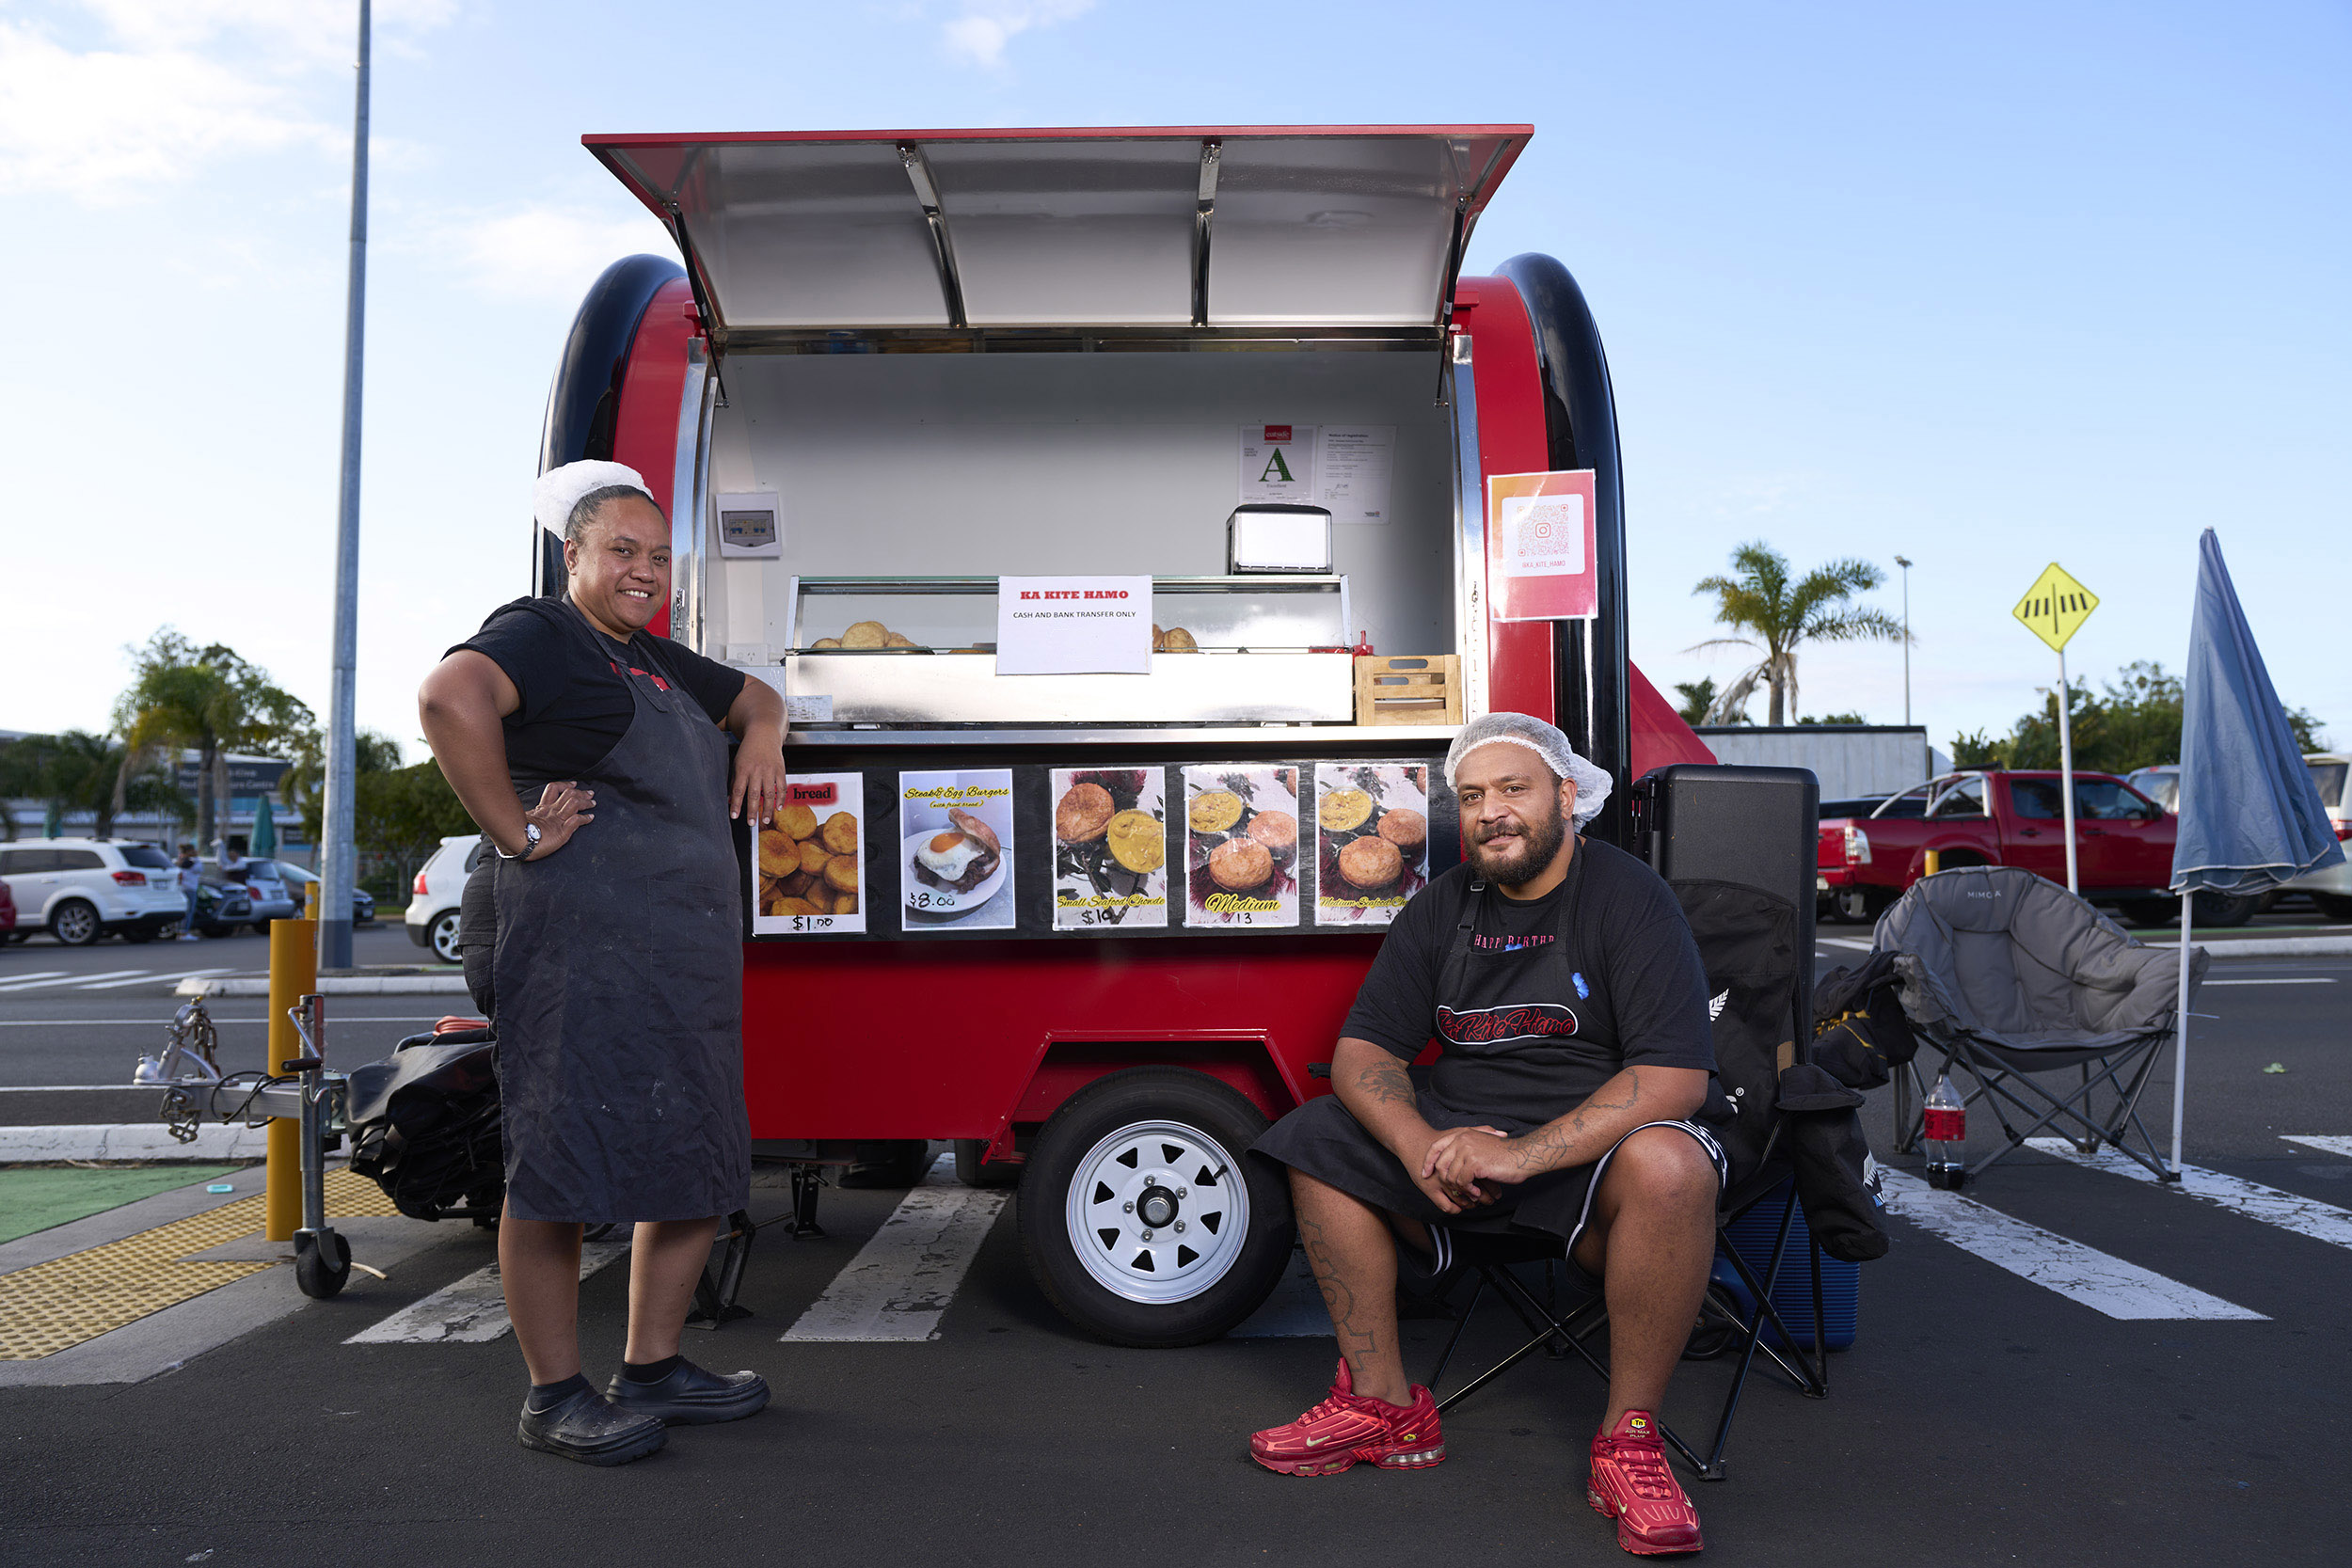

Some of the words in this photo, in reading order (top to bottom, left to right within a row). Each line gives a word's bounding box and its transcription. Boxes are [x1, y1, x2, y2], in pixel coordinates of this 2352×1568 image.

[1258, 447, 1295, 482] A
[1020, 591, 1041, 600] KA
[1043, 591, 1080, 600] KITE
[1083, 590, 1129, 599] HAMO
[793, 787, 832, 800] bread
[944, 786, 965, 800] Egg
[966, 785, 1009, 799] Burgers
[910, 892, 955, 909] $8.00
[1057, 895, 1088, 908] Small
[1089, 895, 1127, 910] Seafood
[1205, 893, 1280, 913] Medium
[1081, 909, 1112, 926] $10
